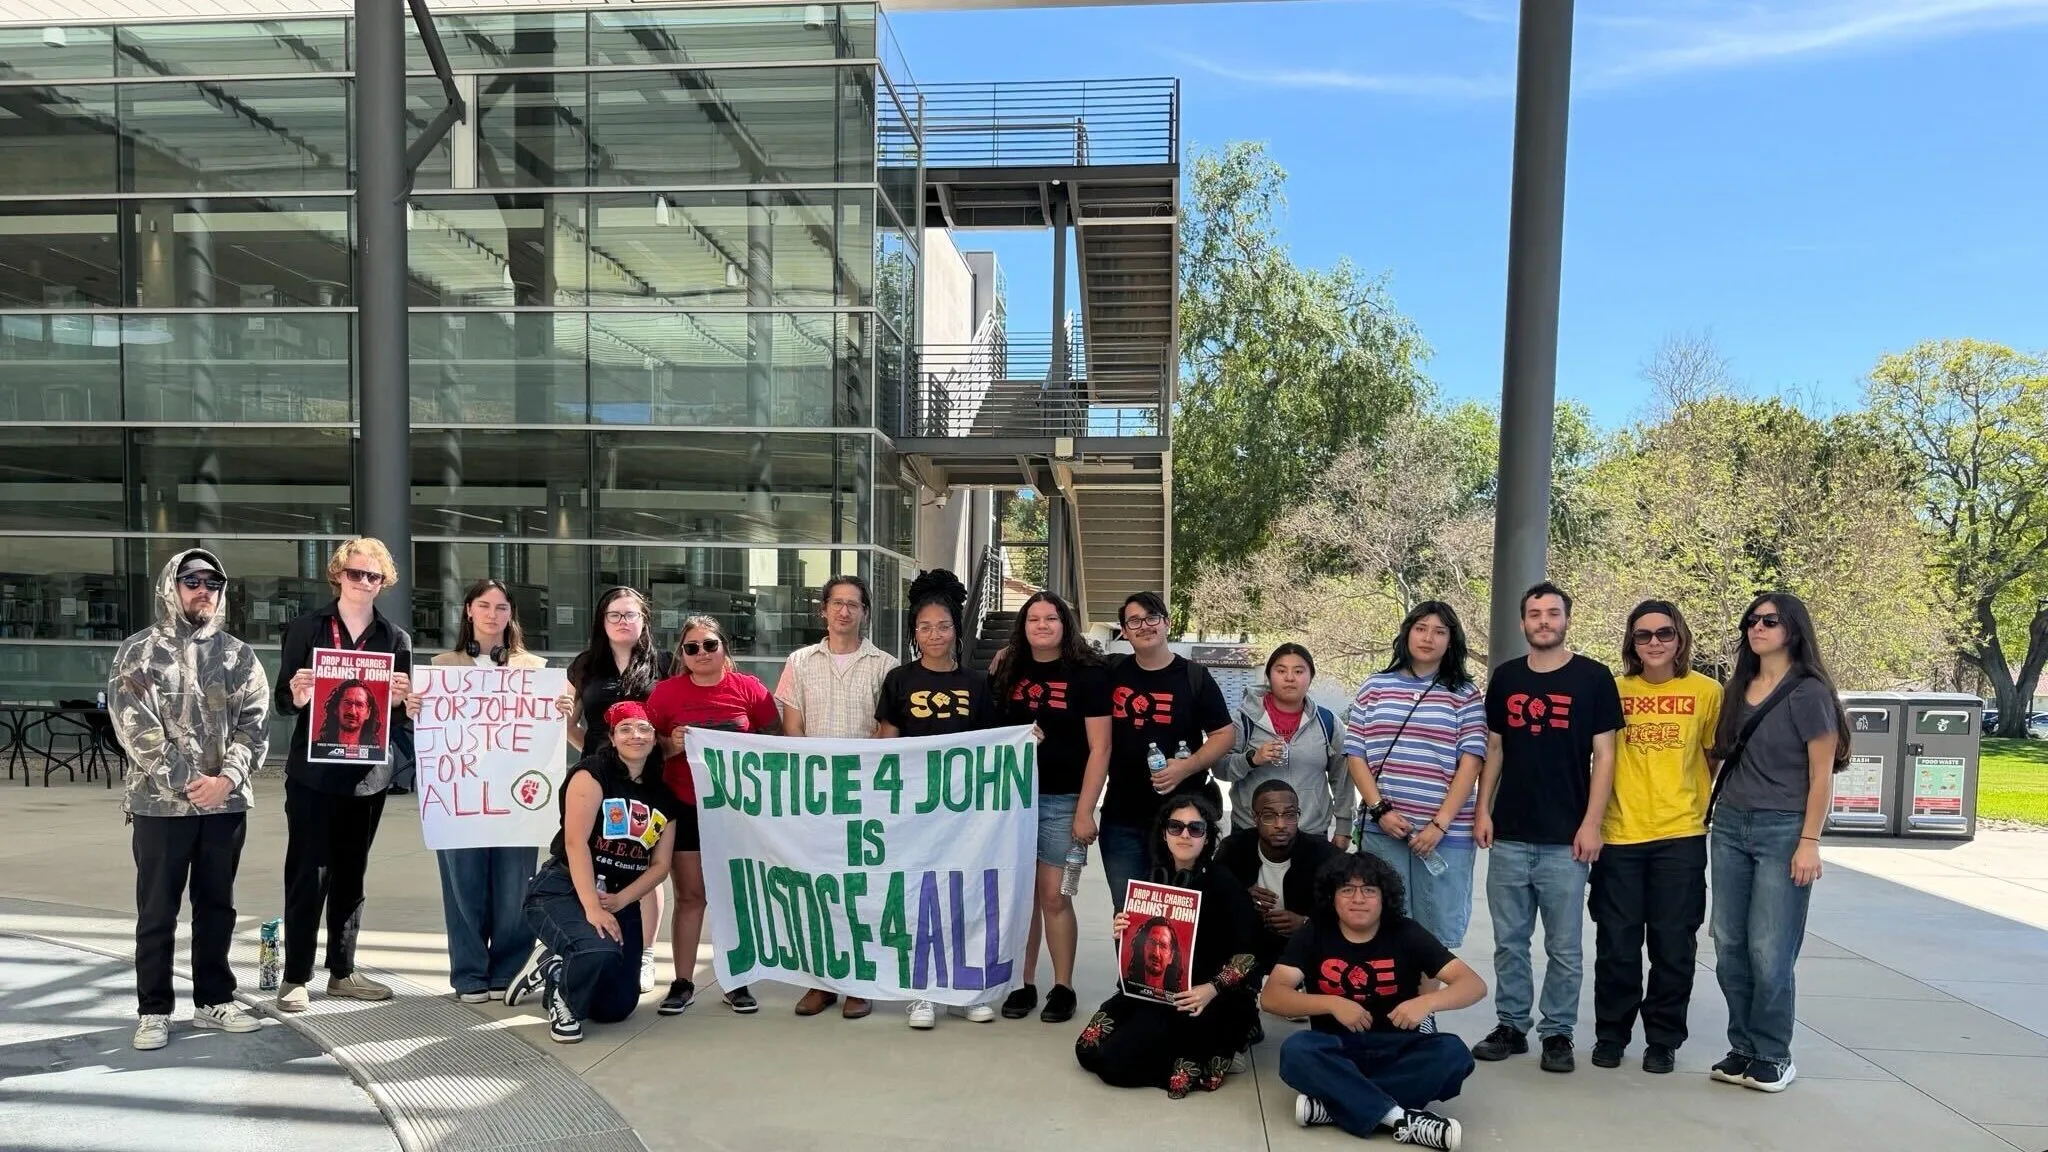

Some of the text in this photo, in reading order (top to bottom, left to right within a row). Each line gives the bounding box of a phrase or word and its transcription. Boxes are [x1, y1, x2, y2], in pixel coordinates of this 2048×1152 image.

[316, 665, 390, 682] AGAINST JOHN
[321, 655, 387, 669] DROP ALL CHARGES
[414, 668, 536, 695] JUSTICE
[419, 753, 478, 787] FOR
[703, 742, 1034, 816] JUSTICE 4 JOHN
[422, 781, 511, 820] ALL
[847, 819, 886, 866] IS
[1127, 898, 1197, 924] AGAINST JOHN
[1133, 887, 1194, 908] DROP ALL CHARGES
